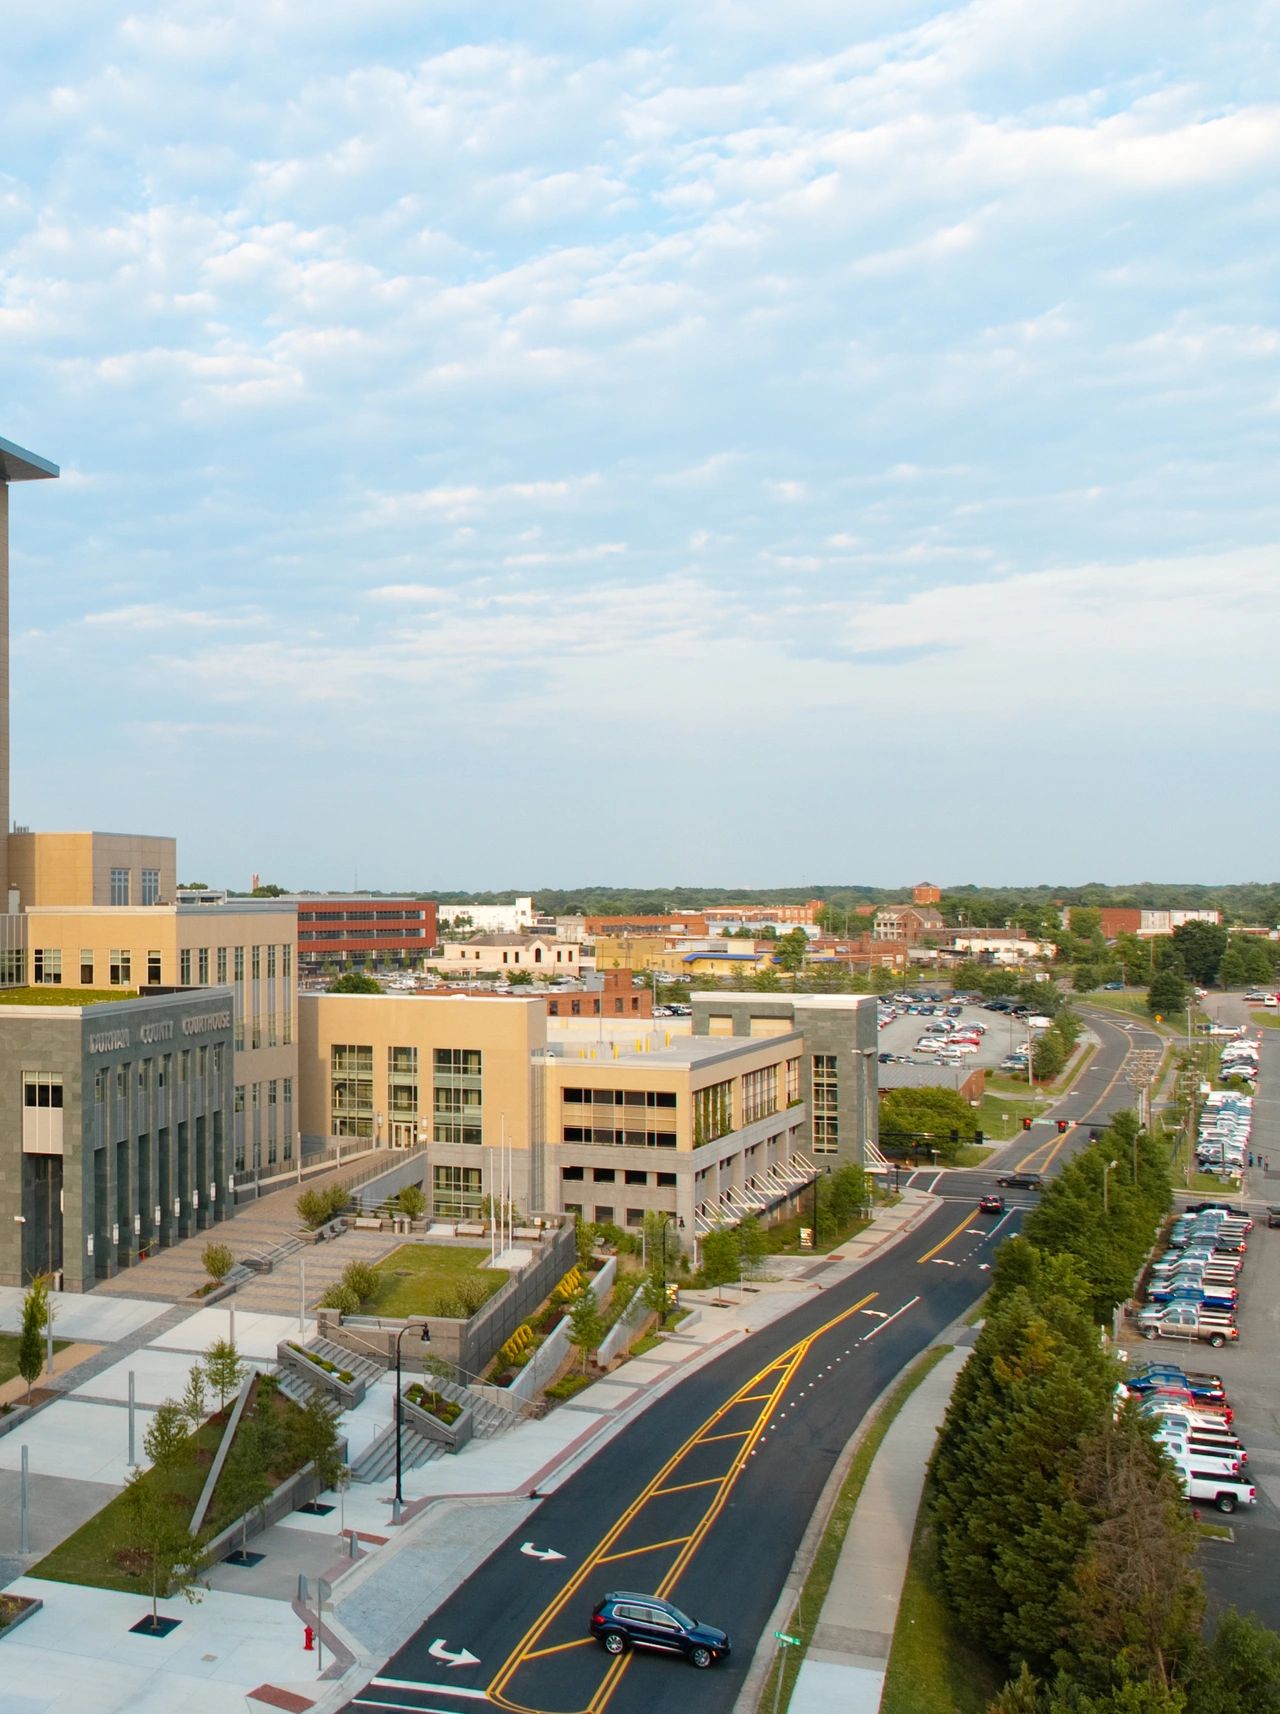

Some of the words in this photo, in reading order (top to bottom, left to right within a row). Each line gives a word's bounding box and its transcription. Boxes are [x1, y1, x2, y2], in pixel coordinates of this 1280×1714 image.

[89, 1028, 130, 1054] DURHAM
[140, 1020, 173, 1044] COUNTY
[182, 1010, 230, 1036] COURTHOUSE
